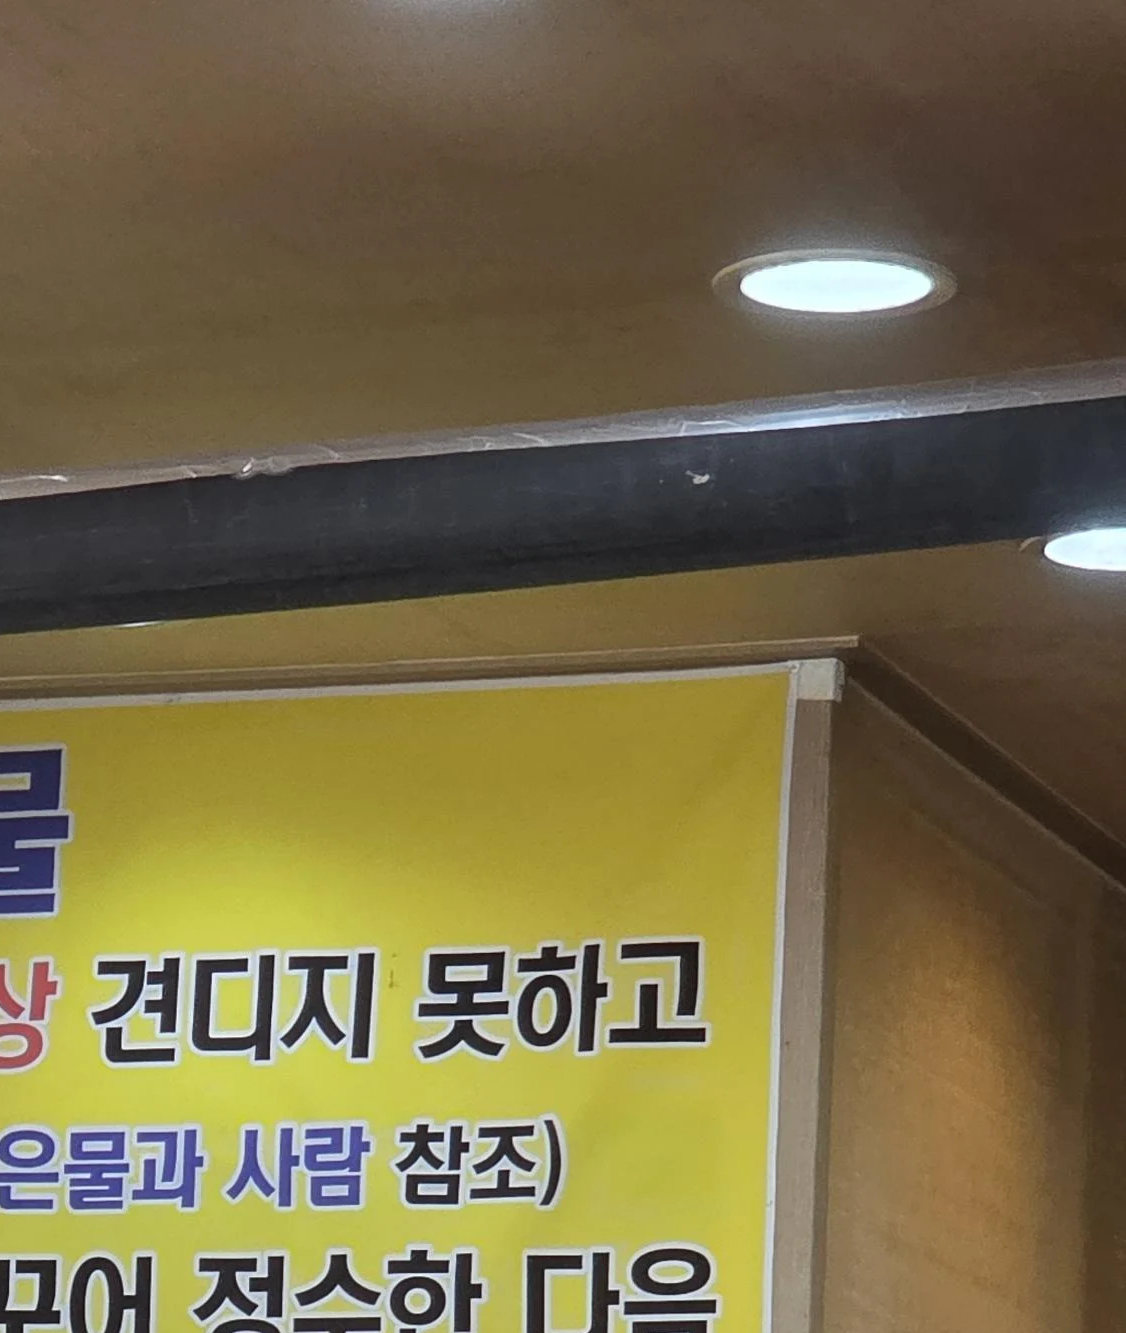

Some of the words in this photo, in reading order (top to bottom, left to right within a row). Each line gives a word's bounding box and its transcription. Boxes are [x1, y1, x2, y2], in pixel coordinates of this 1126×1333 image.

[93, 953, 374, 1062] 견디지
[419, 942, 705, 1057] 못하고
[228, 1127, 370, 1206] 사람
[398, 1120, 561, 1205] 참조)
